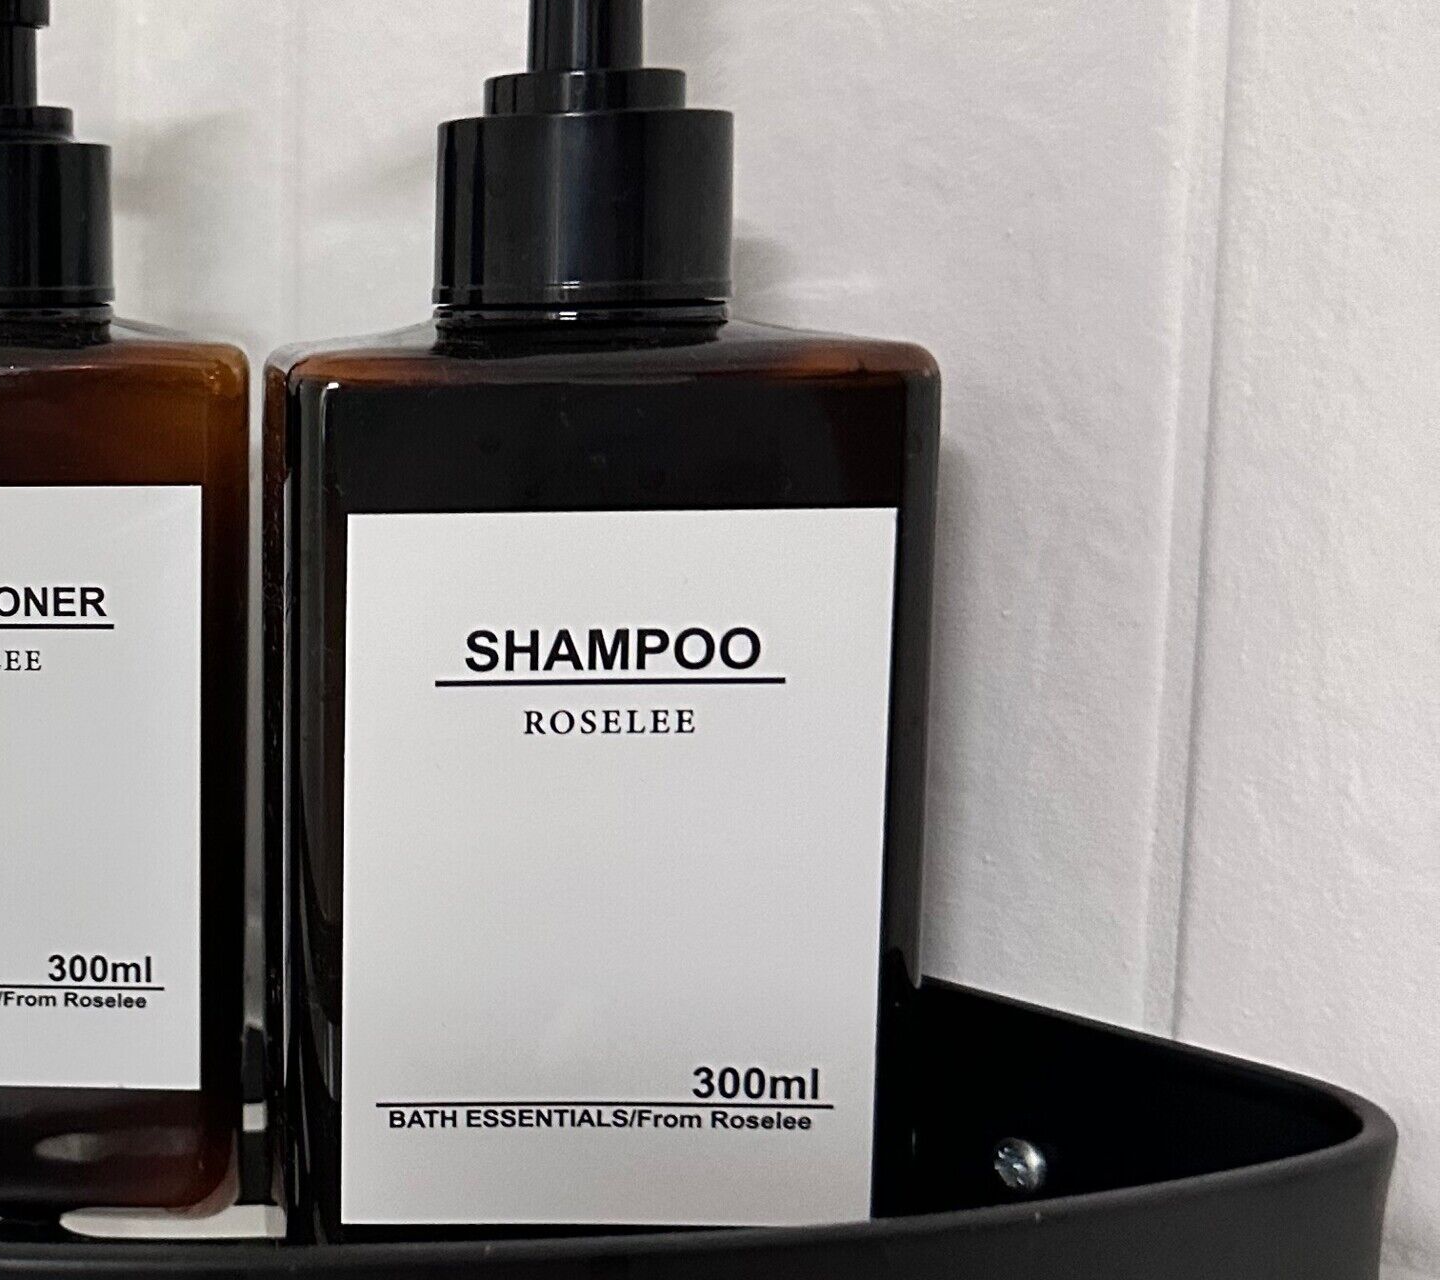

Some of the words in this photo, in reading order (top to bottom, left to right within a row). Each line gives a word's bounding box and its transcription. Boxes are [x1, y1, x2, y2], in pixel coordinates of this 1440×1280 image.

[464, 626, 762, 672] SHAMPOO
[523, 708, 698, 736] ROSELEE
[47, 954, 153, 983] 300ml
[63, 992, 148, 1009] Roselee
[691, 1066, 821, 1101] 300ml
[388, 1110, 458, 1129] BATH
[465, 1108, 703, 1130] ESSENTIALS/From
[710, 1111, 813, 1131] Roselee
